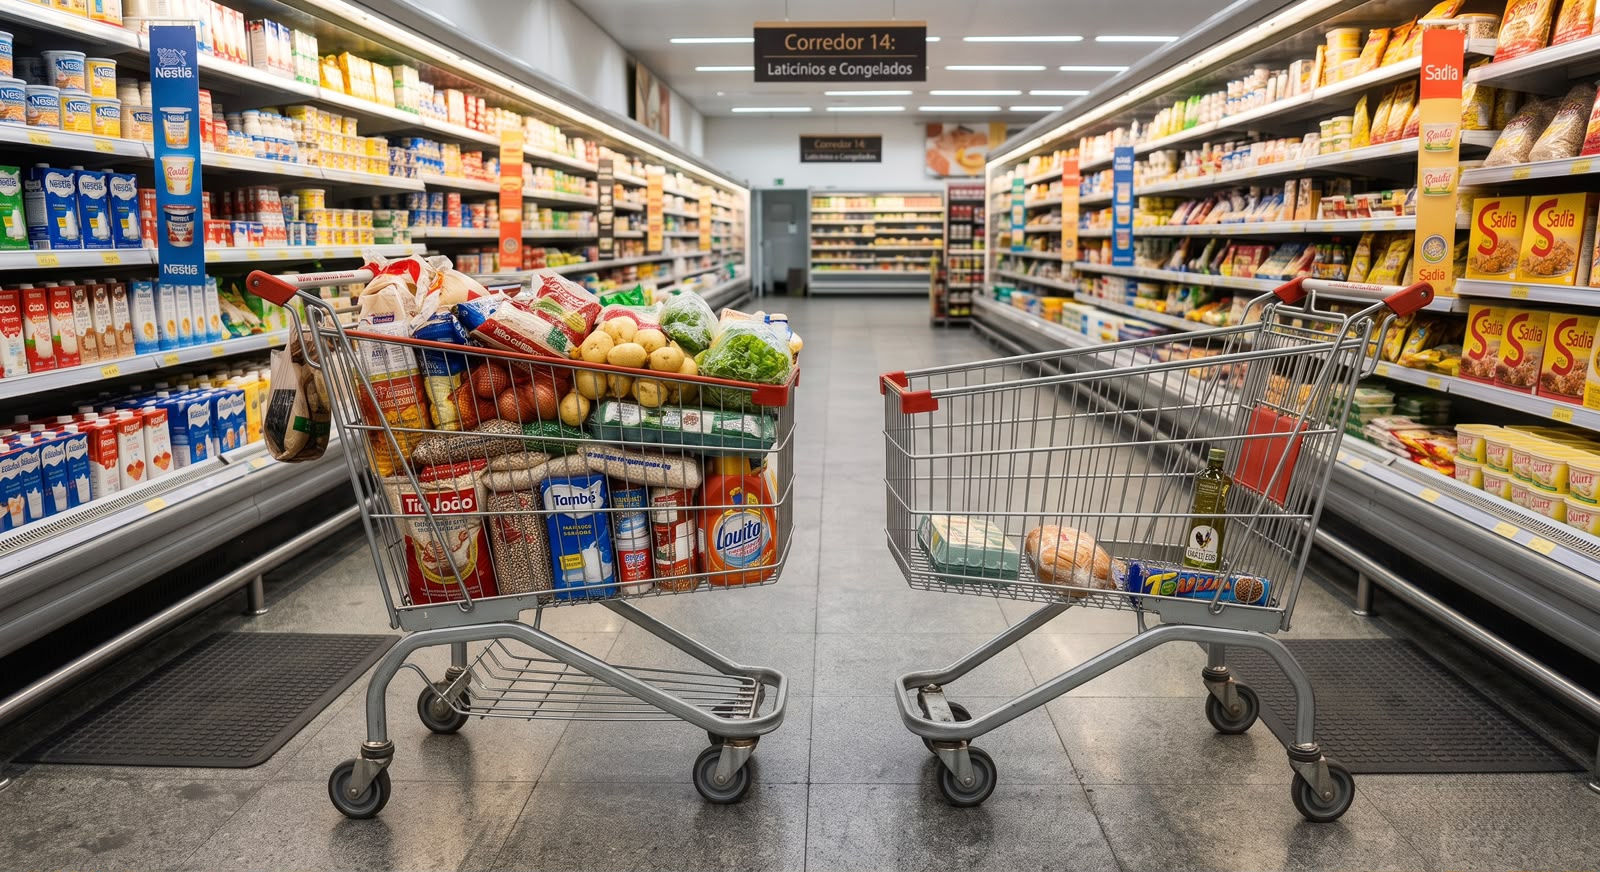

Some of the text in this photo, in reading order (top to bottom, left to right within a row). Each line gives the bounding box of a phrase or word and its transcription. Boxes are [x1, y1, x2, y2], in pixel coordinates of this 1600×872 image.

[785, 33, 896, 51] Corredor 14:
[767, 61, 913, 78] Laticínios e Congelados
[1425, 64, 1459, 81] Sadia
[1490, 210, 1518, 229] Sadia
[1546, 209, 1576, 229] Sadia
[1418, 269, 1446, 282] Sadia
[1481, 318, 1503, 337] Sadia
[1517, 323, 1543, 342] Sadia
[1565, 329, 1594, 349] Sadia
[433, 496, 473, 513] João
[553, 490, 597, 507] També
